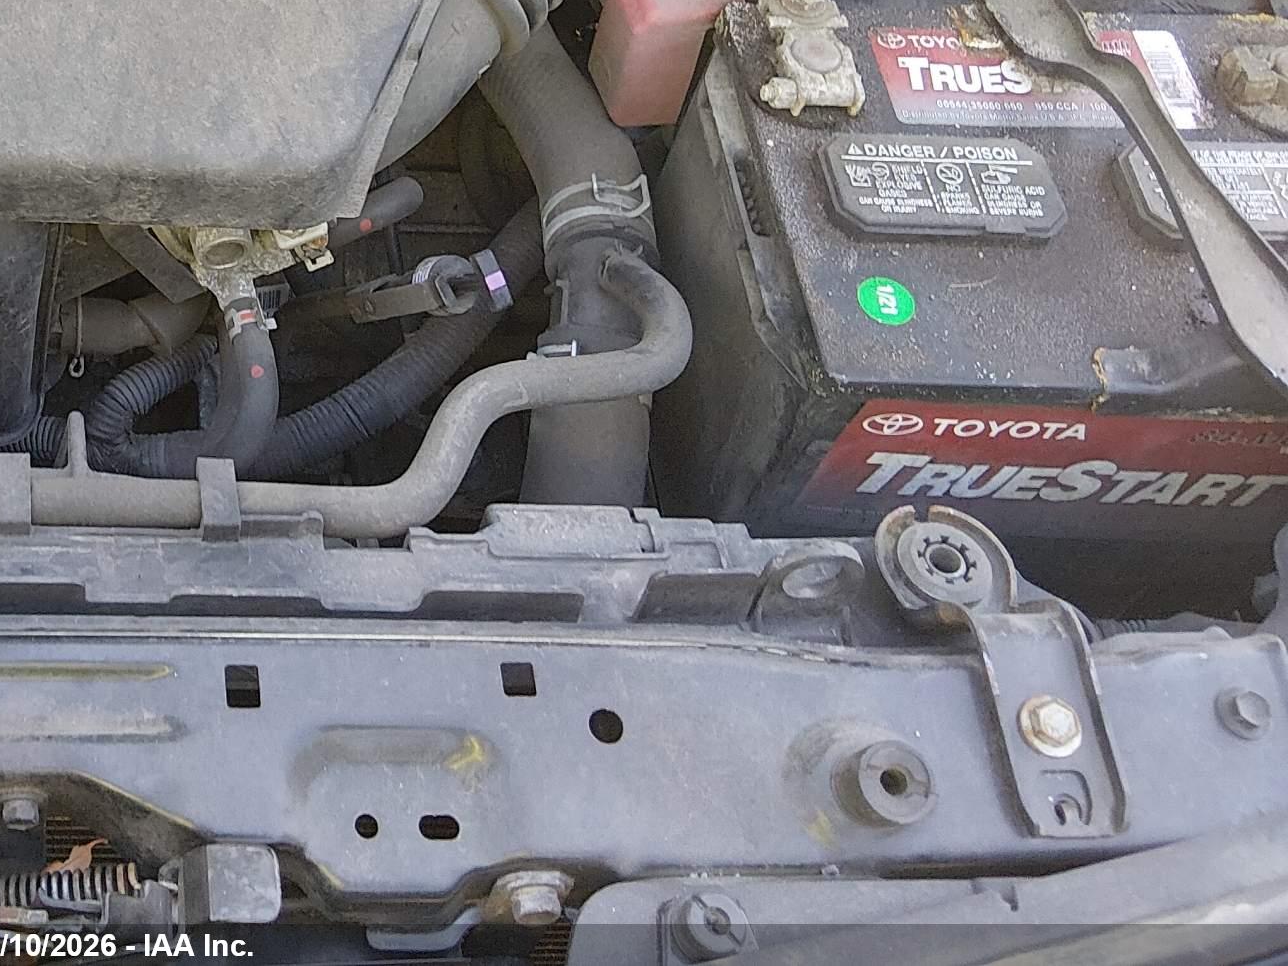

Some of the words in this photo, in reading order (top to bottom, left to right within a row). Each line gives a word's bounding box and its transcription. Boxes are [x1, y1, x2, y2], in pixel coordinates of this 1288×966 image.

[907, 35, 961, 49] TOYO
[863, 144, 935, 158] DANGER
[940, 146, 947, 158] /
[954, 146, 1018, 160] POISON
[1025, 186, 1046, 196] ACID
[933, 417, 1087, 441] TOYOTA
